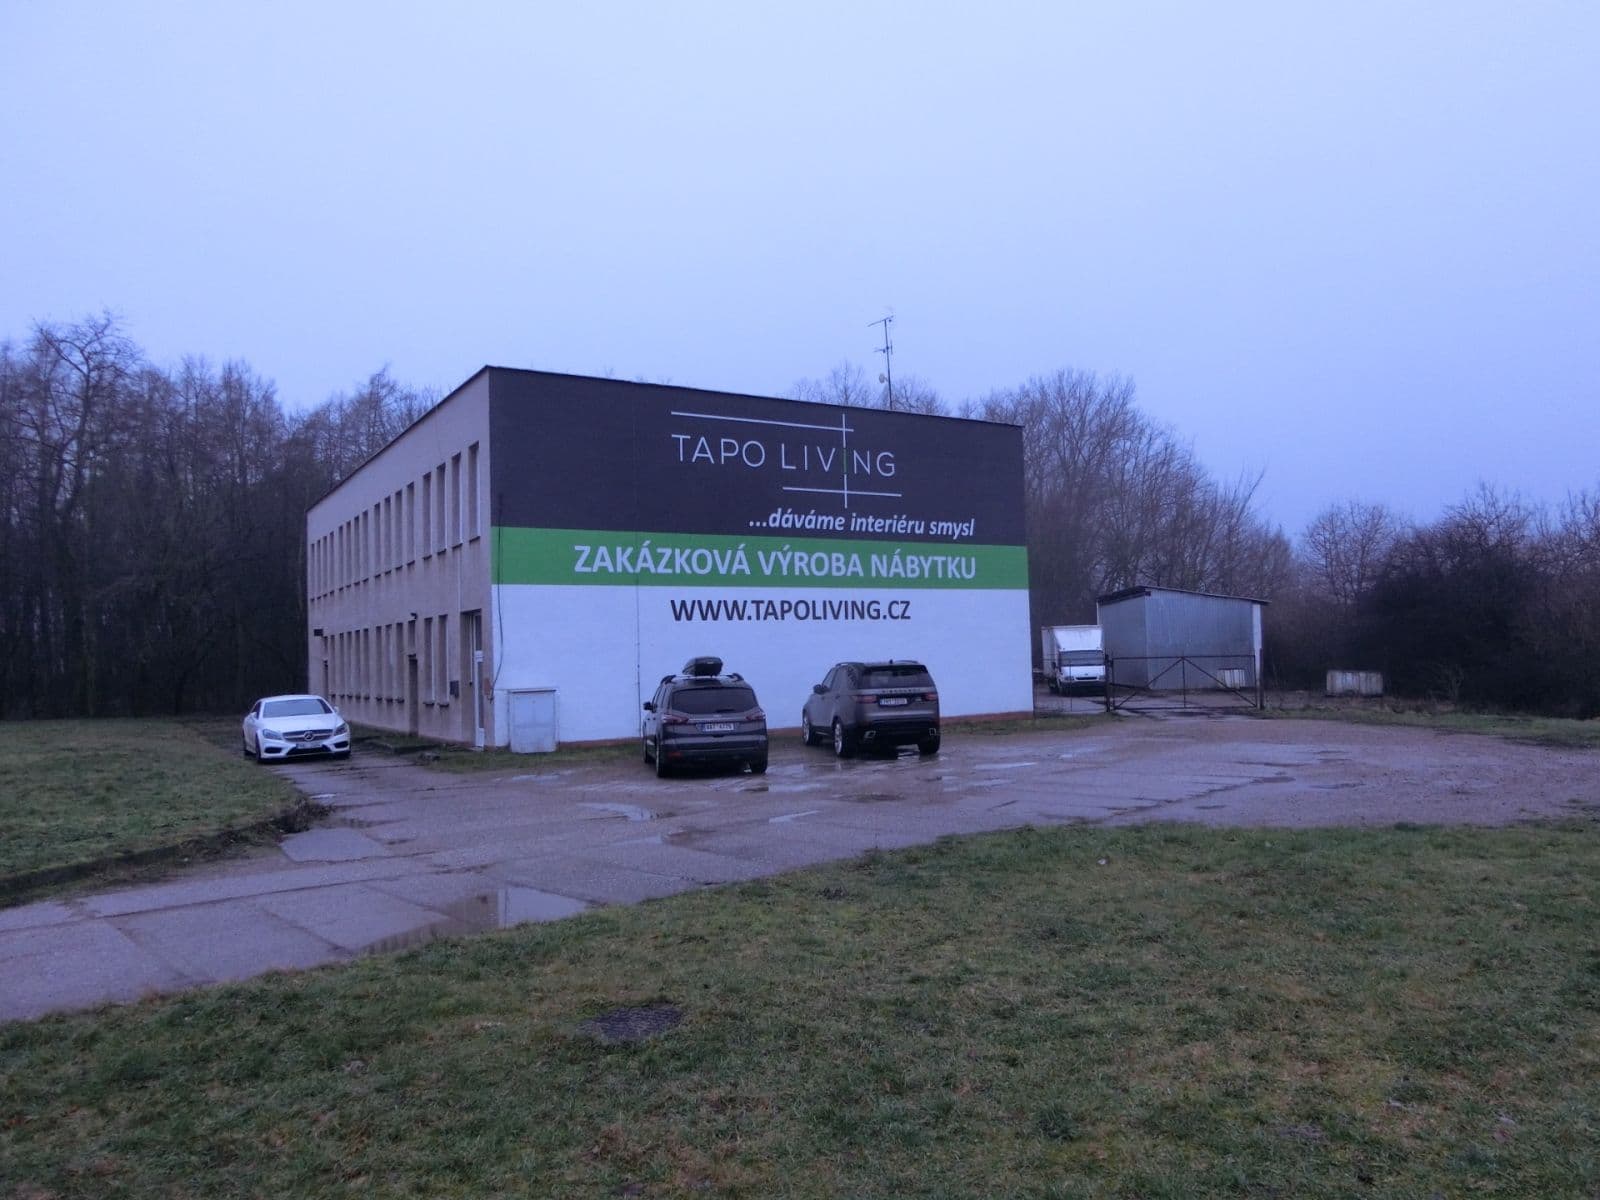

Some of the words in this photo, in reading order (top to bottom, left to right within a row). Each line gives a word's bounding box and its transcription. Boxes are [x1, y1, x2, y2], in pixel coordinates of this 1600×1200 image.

[671, 434, 765, 467] TAPO
[781, 442, 896, 477] LIVING
[749, 507, 846, 531] ...dáváme
[850, 512, 925, 535] interiéru
[929, 518, 975, 540] smysl
[573, 540, 751, 574] ZAKÁZKOVÁ
[757, 544, 864, 577] VÝROBA
[870, 548, 976, 580] NÁBYTKU
[670, 599, 911, 621] WWW.TAPOLIVING.CZ
